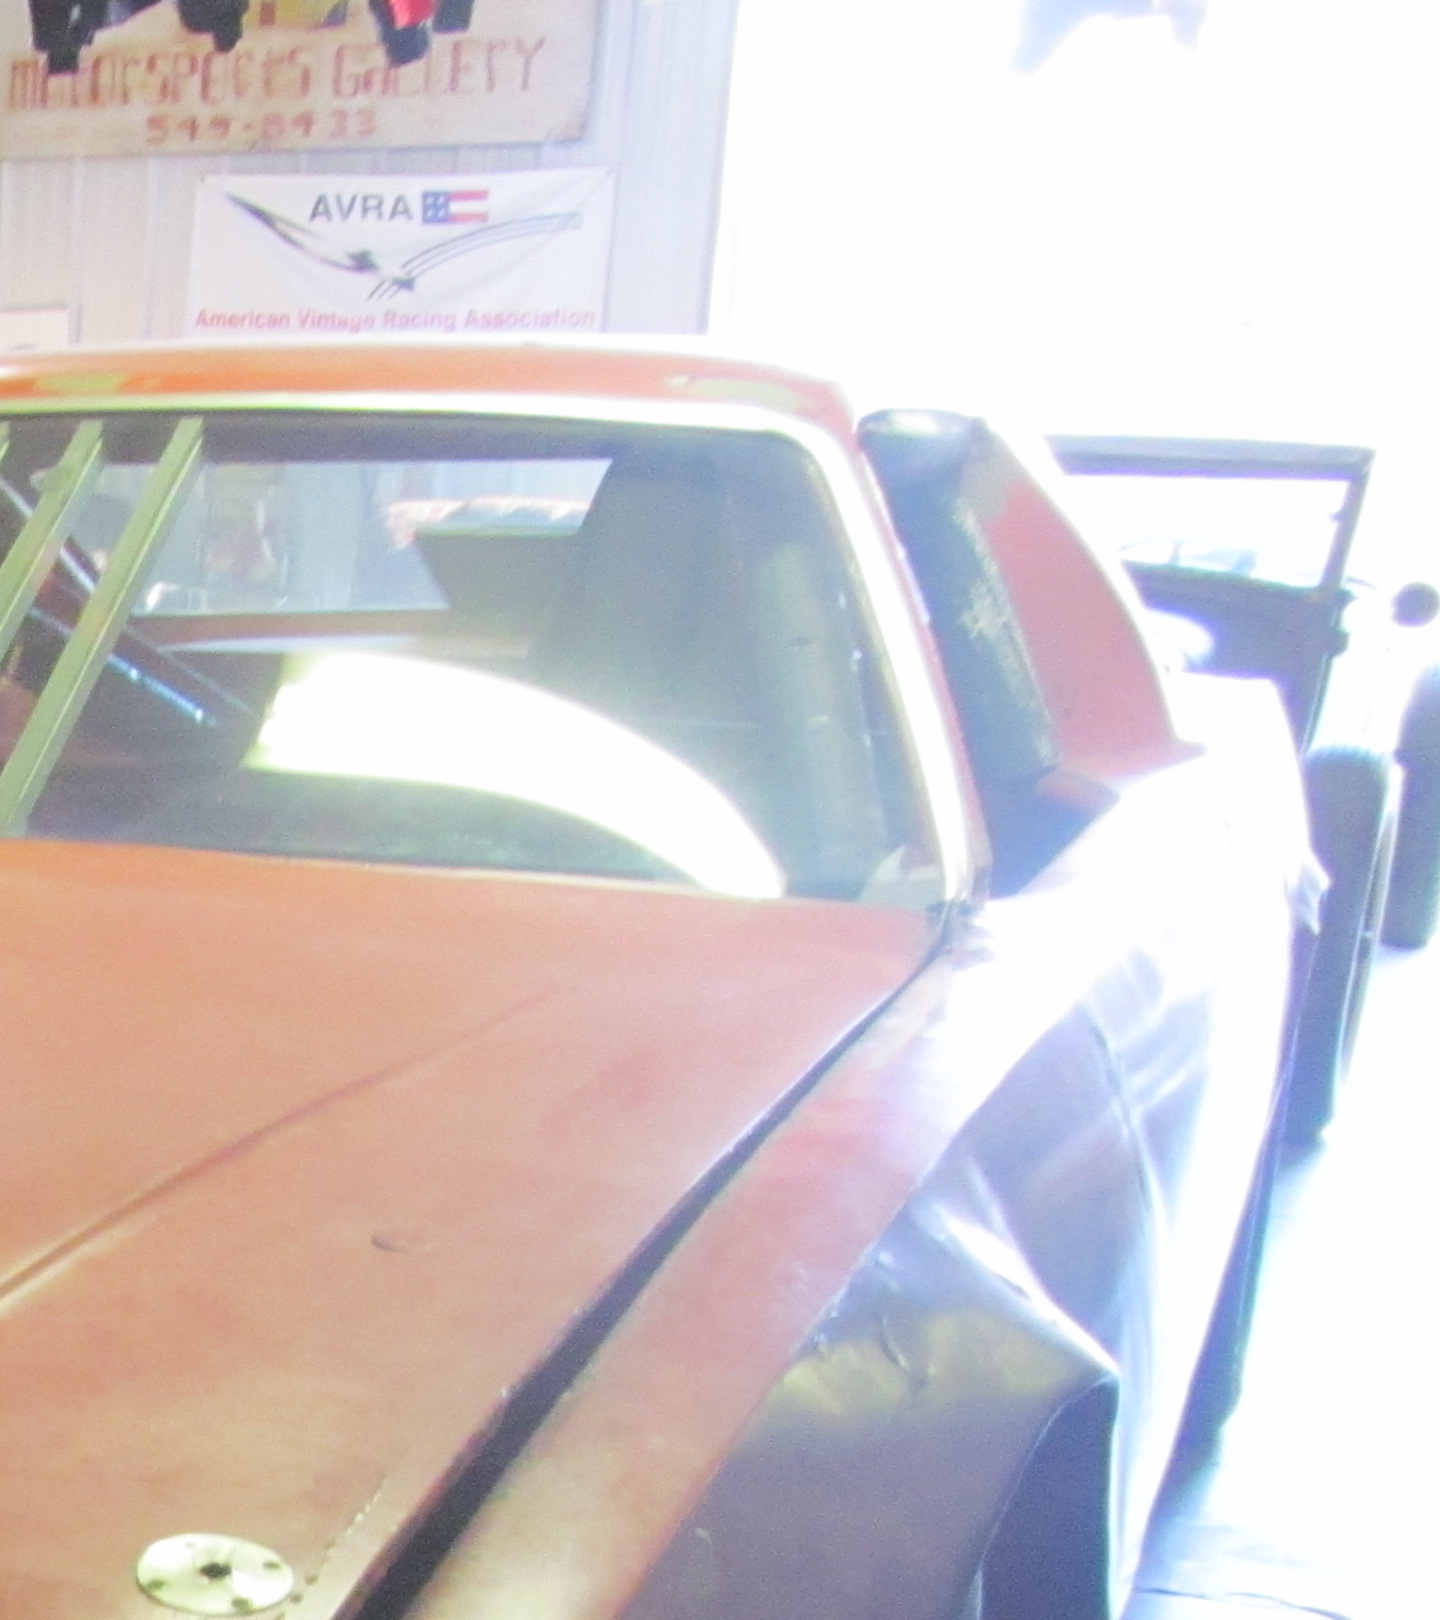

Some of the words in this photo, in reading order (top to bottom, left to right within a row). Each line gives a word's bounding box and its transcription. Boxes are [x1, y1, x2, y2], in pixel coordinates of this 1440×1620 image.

[308, 193, 414, 223] AVRA
[195, 308, 290, 329] American
[298, 308, 375, 333] Vintage
[383, 308, 458, 333] Racing
[465, 307, 595, 331] Association
